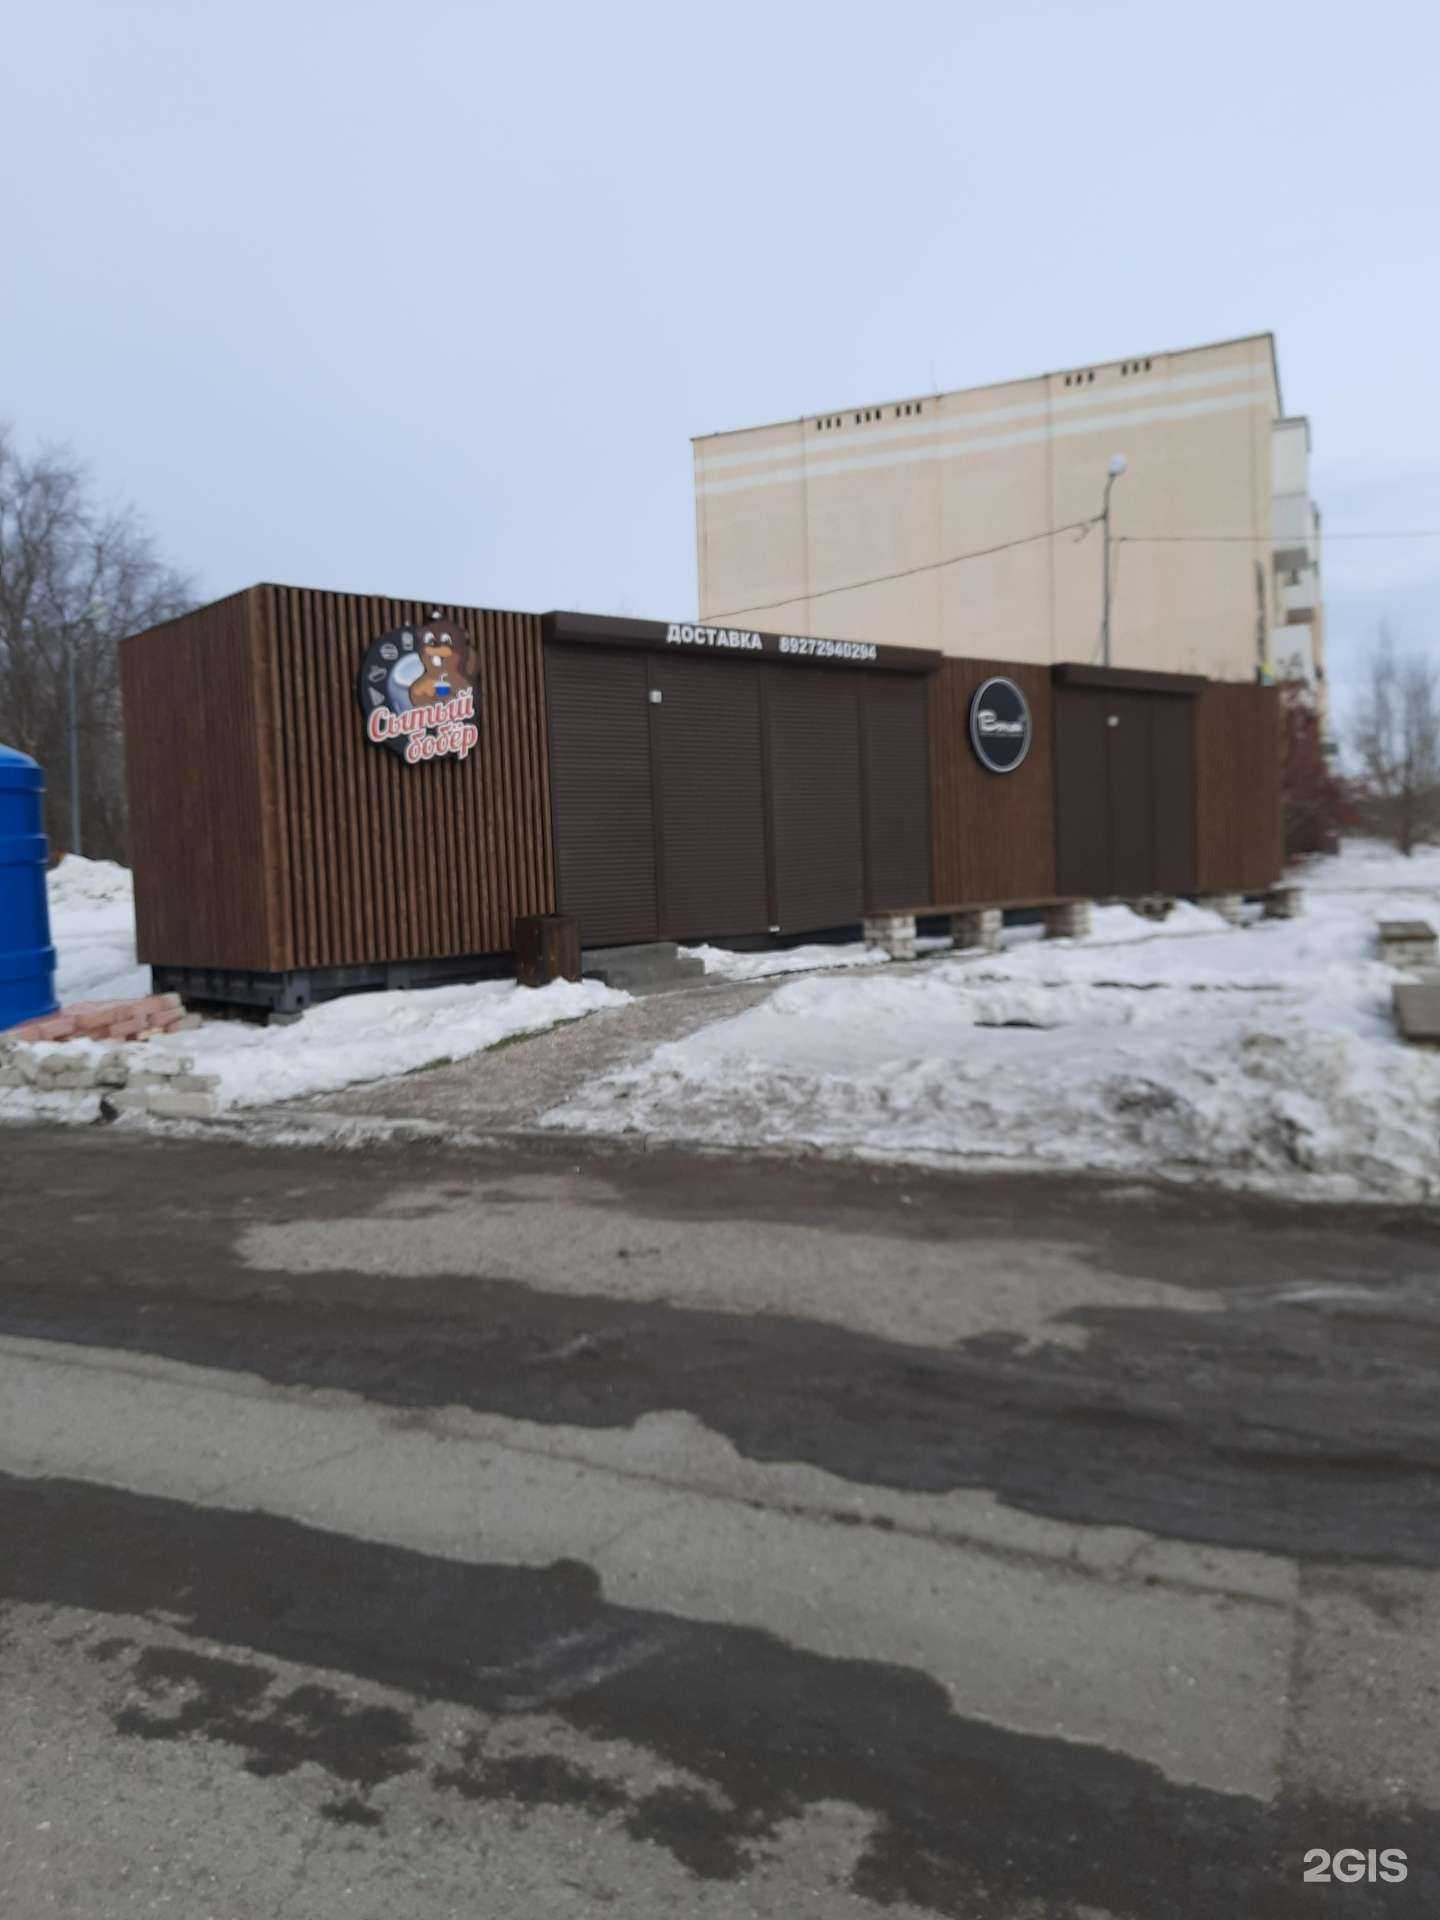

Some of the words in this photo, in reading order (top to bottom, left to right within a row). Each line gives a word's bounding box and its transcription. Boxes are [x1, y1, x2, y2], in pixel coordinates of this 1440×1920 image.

[666, 624, 762, 650] ДОСТАВКА
[368, 687, 475, 742] Сытый
[405, 721, 478, 763] бобёр
